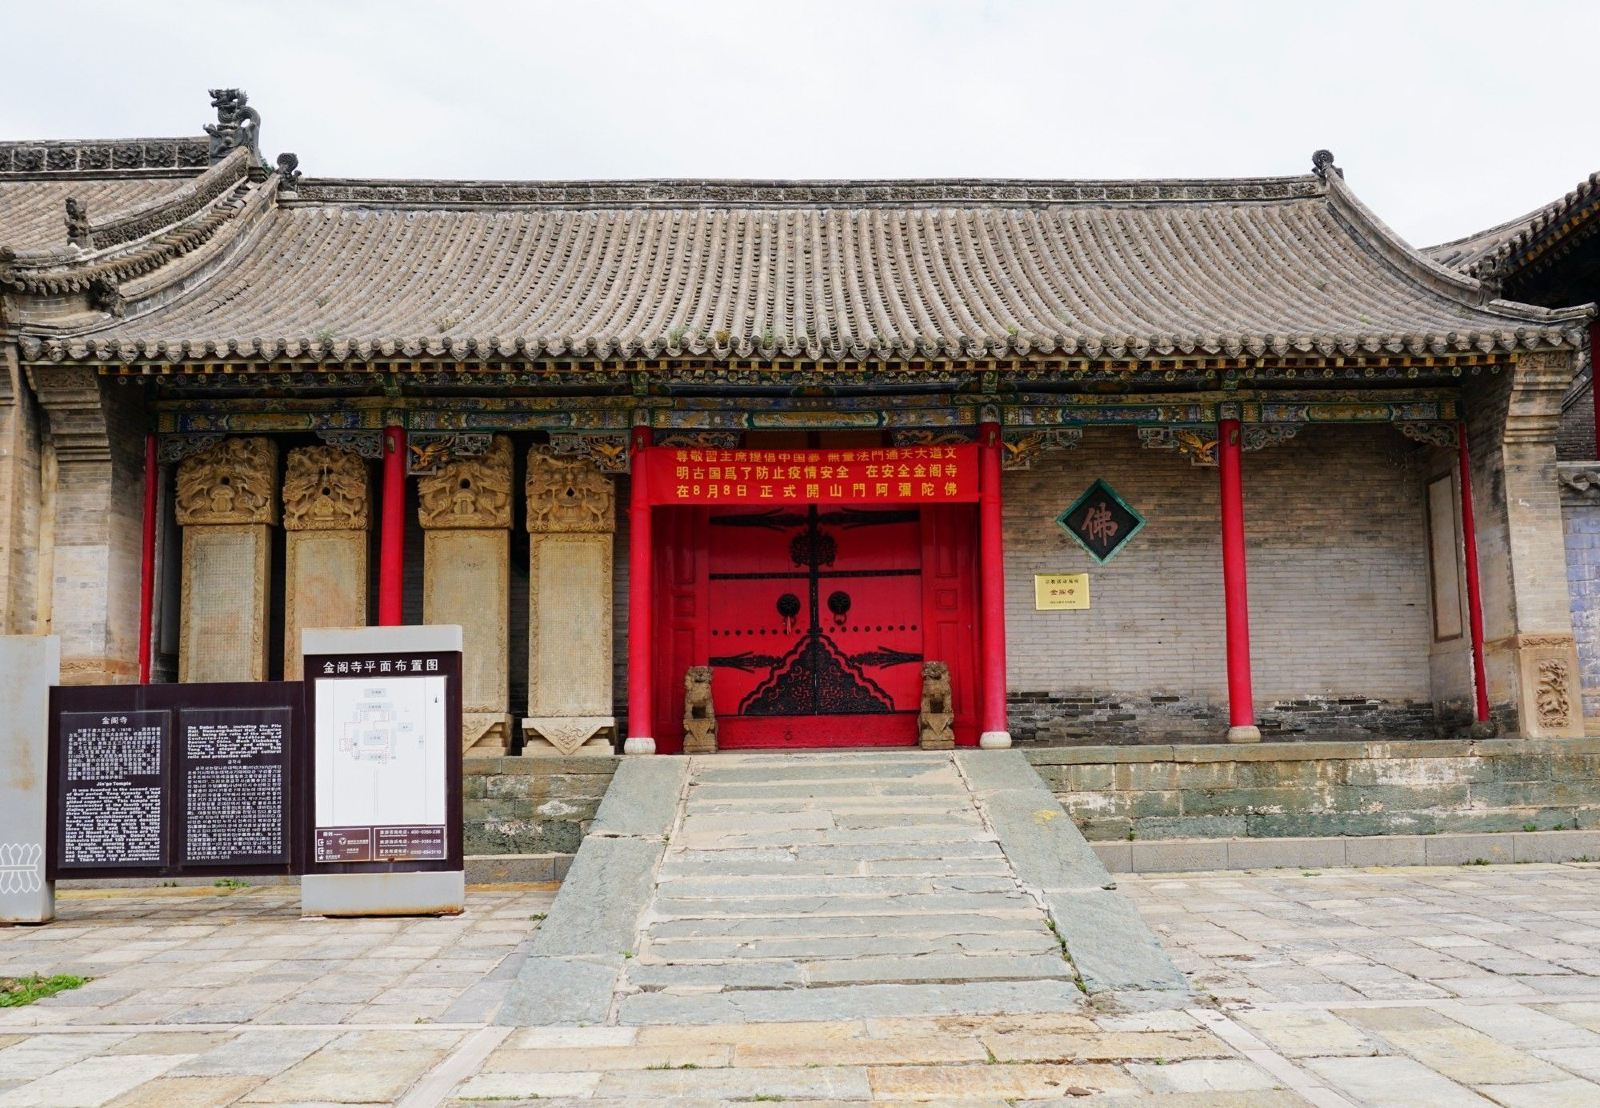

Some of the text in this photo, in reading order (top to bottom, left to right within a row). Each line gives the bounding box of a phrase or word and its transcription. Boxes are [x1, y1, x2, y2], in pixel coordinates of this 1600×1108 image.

[1081, 501, 1118, 547] 佛
[323, 659, 438, 674] 金阁寺平面布置图
